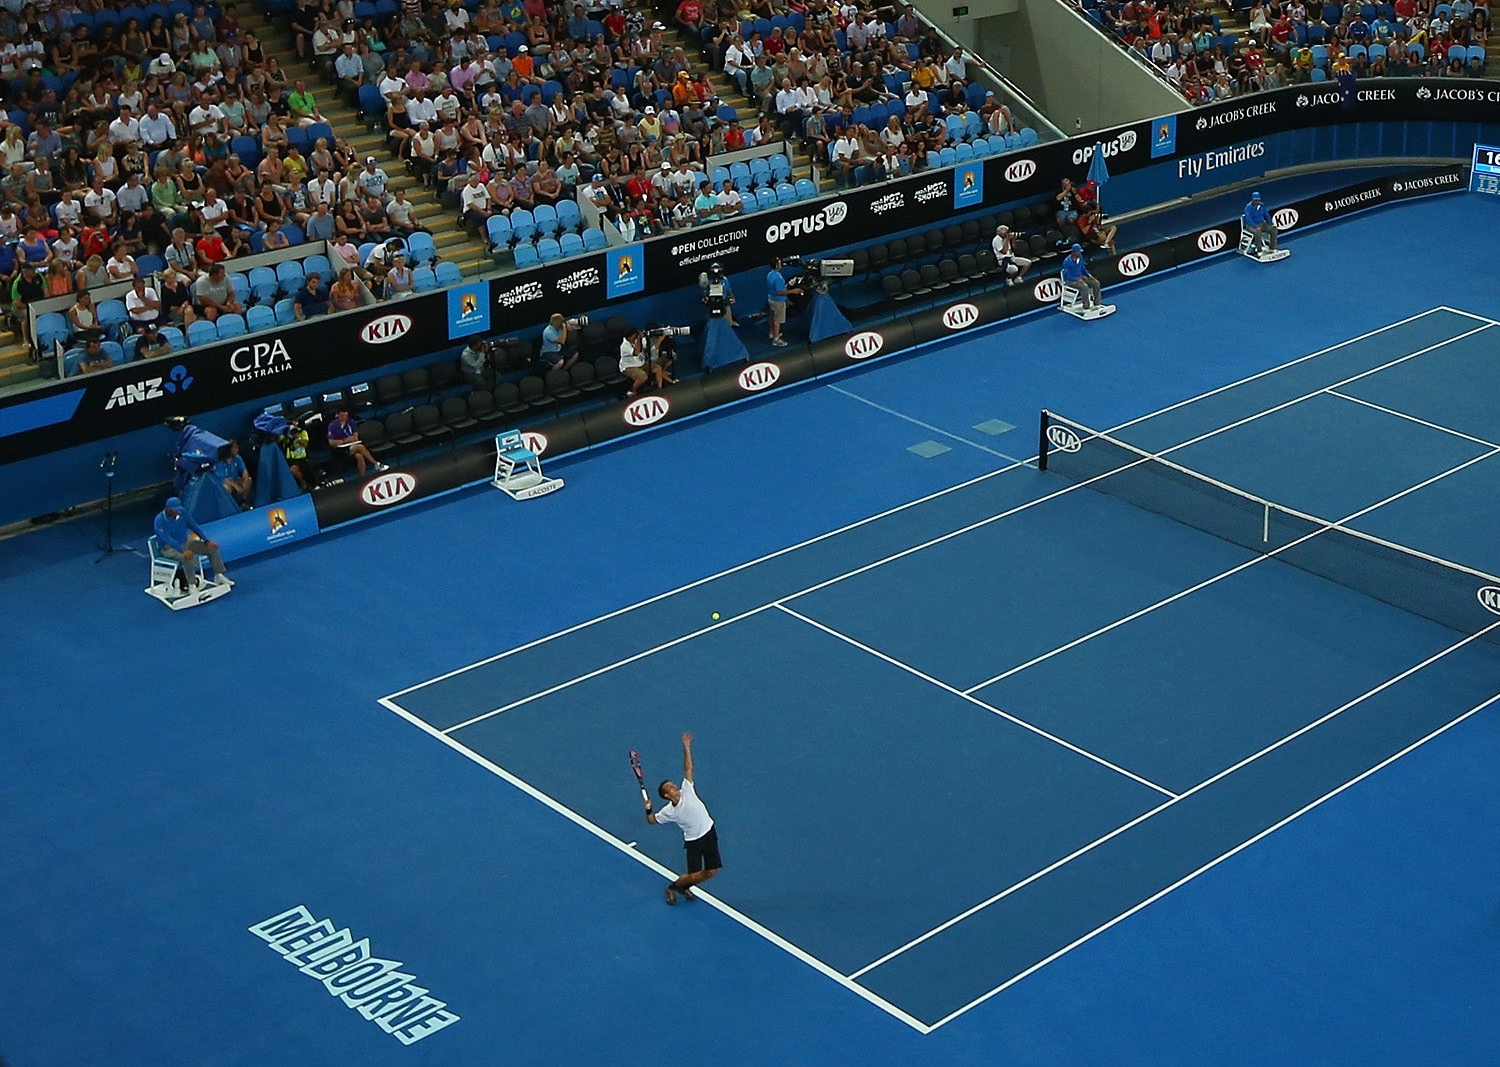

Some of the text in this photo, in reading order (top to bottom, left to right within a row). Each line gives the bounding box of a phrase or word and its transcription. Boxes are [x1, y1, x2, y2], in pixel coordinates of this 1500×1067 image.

[1310, 89, 1396, 107] JACO CREEK
[1433, 87, 1484, 102] JACOB'S
[1209, 101, 1277, 129] JACOB'S CREEK
[1072, 139, 1119, 165] OPUS
[1178, 140, 1265, 179] Fly Emirates
[1008, 163, 1032, 180] KIA
[1404, 173, 1460, 192] JACOB'S CREEK
[1360, 187, 1382, 205] CREEK
[828, 204, 845, 222] yes
[1275, 211, 1296, 227] KIA
[765, 212, 825, 243] OPTUS
[697, 229, 748, 249] COLLECTION
[1200, 232, 1224, 248] KIA
[679, 245, 740, 266] official merchandise
[1121, 255, 1146, 273] KIA
[573, 267, 595, 280] HOT
[515, 281, 538, 294] HOT
[560, 277, 592, 292] SHOTS
[502, 291, 534, 307] SHOTS
[947, 307, 974, 325] KIA
[368, 317, 406, 342] KIA
[849, 336, 879, 354] KIA
[230, 338, 292, 373] CPA
[231, 362, 293, 384] AUSTRALIA
[744, 367, 777, 386] KIA
[105, 376, 164, 411] ANZ
[630, 401, 665, 422] KIA
[1052, 428, 1076, 449] KIA
[369, 478, 408, 502] KIA
[529, 484, 557, 497] LACOSTE
[247, 904, 461, 1046] MELBOURNE
